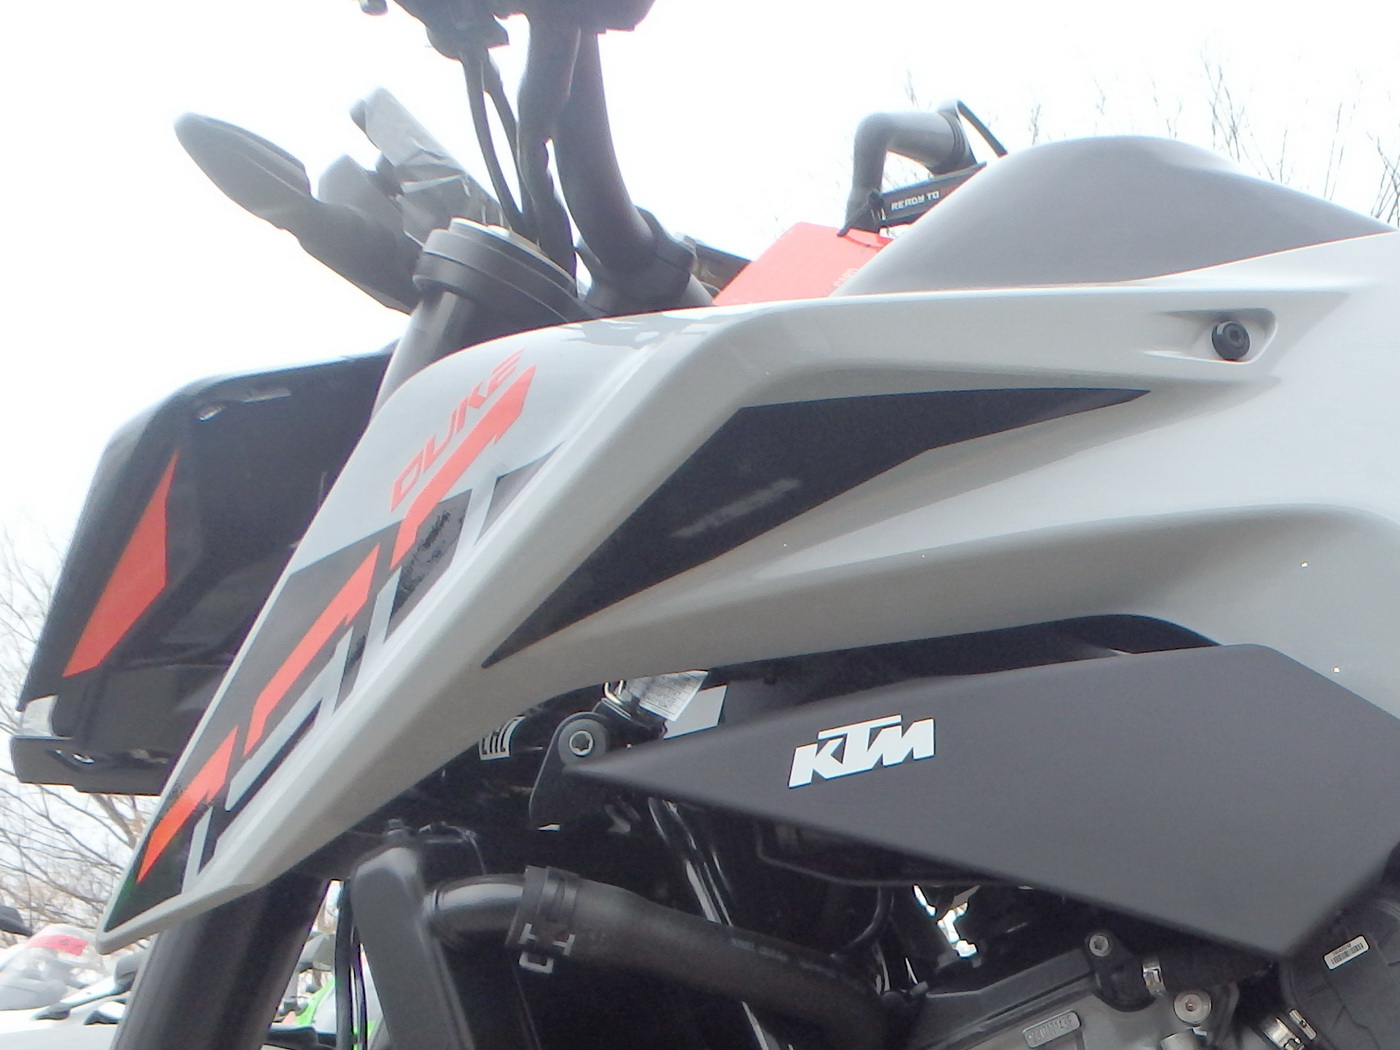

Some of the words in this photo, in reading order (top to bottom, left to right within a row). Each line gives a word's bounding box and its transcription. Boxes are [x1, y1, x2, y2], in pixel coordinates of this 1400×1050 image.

[891, 195, 925, 211] READY
[926, 190, 940, 201] TO
[389, 347, 527, 513] DUKE
[788, 714, 936, 789] KTM
